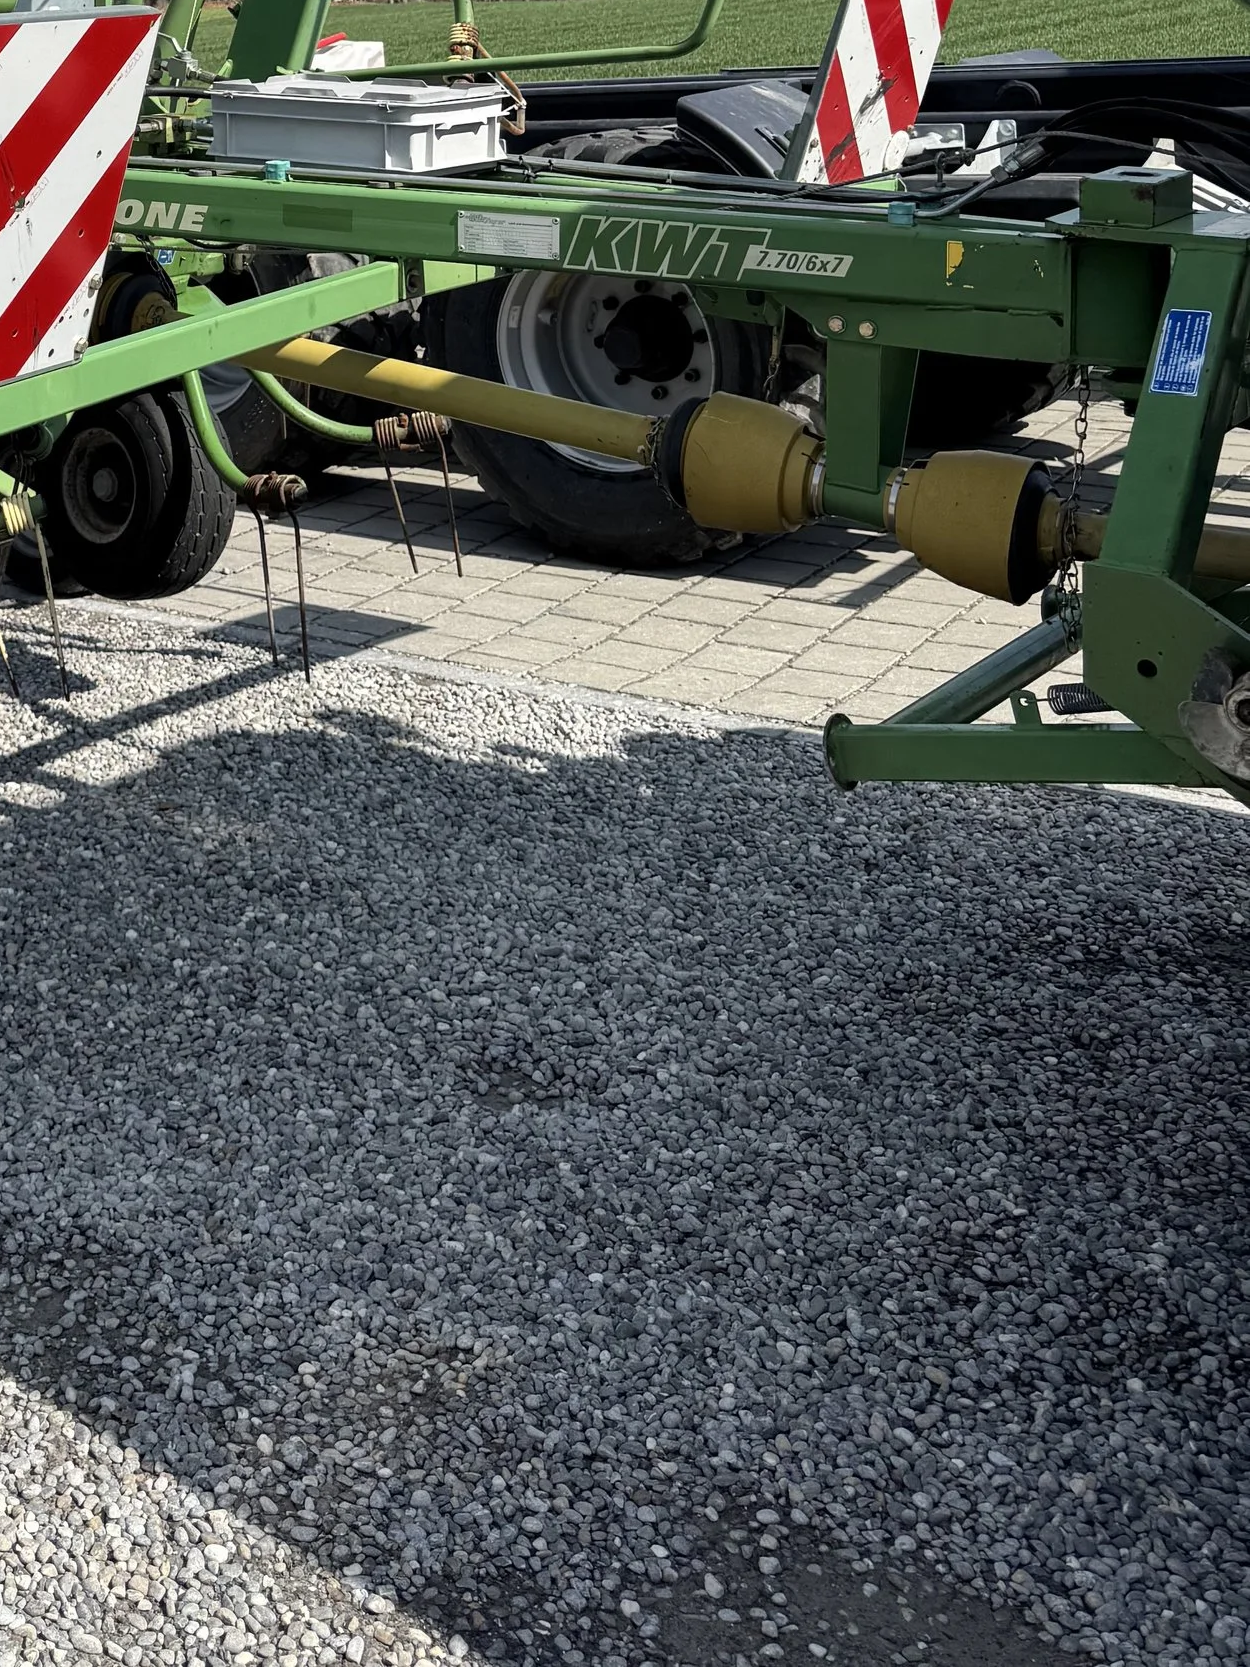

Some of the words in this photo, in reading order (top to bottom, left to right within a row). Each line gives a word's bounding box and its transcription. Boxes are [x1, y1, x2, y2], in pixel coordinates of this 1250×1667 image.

[113, 198, 209, 233] ONE
[563, 215, 772, 282] KWT
[756, 249, 846, 274] 7.70/6x7
